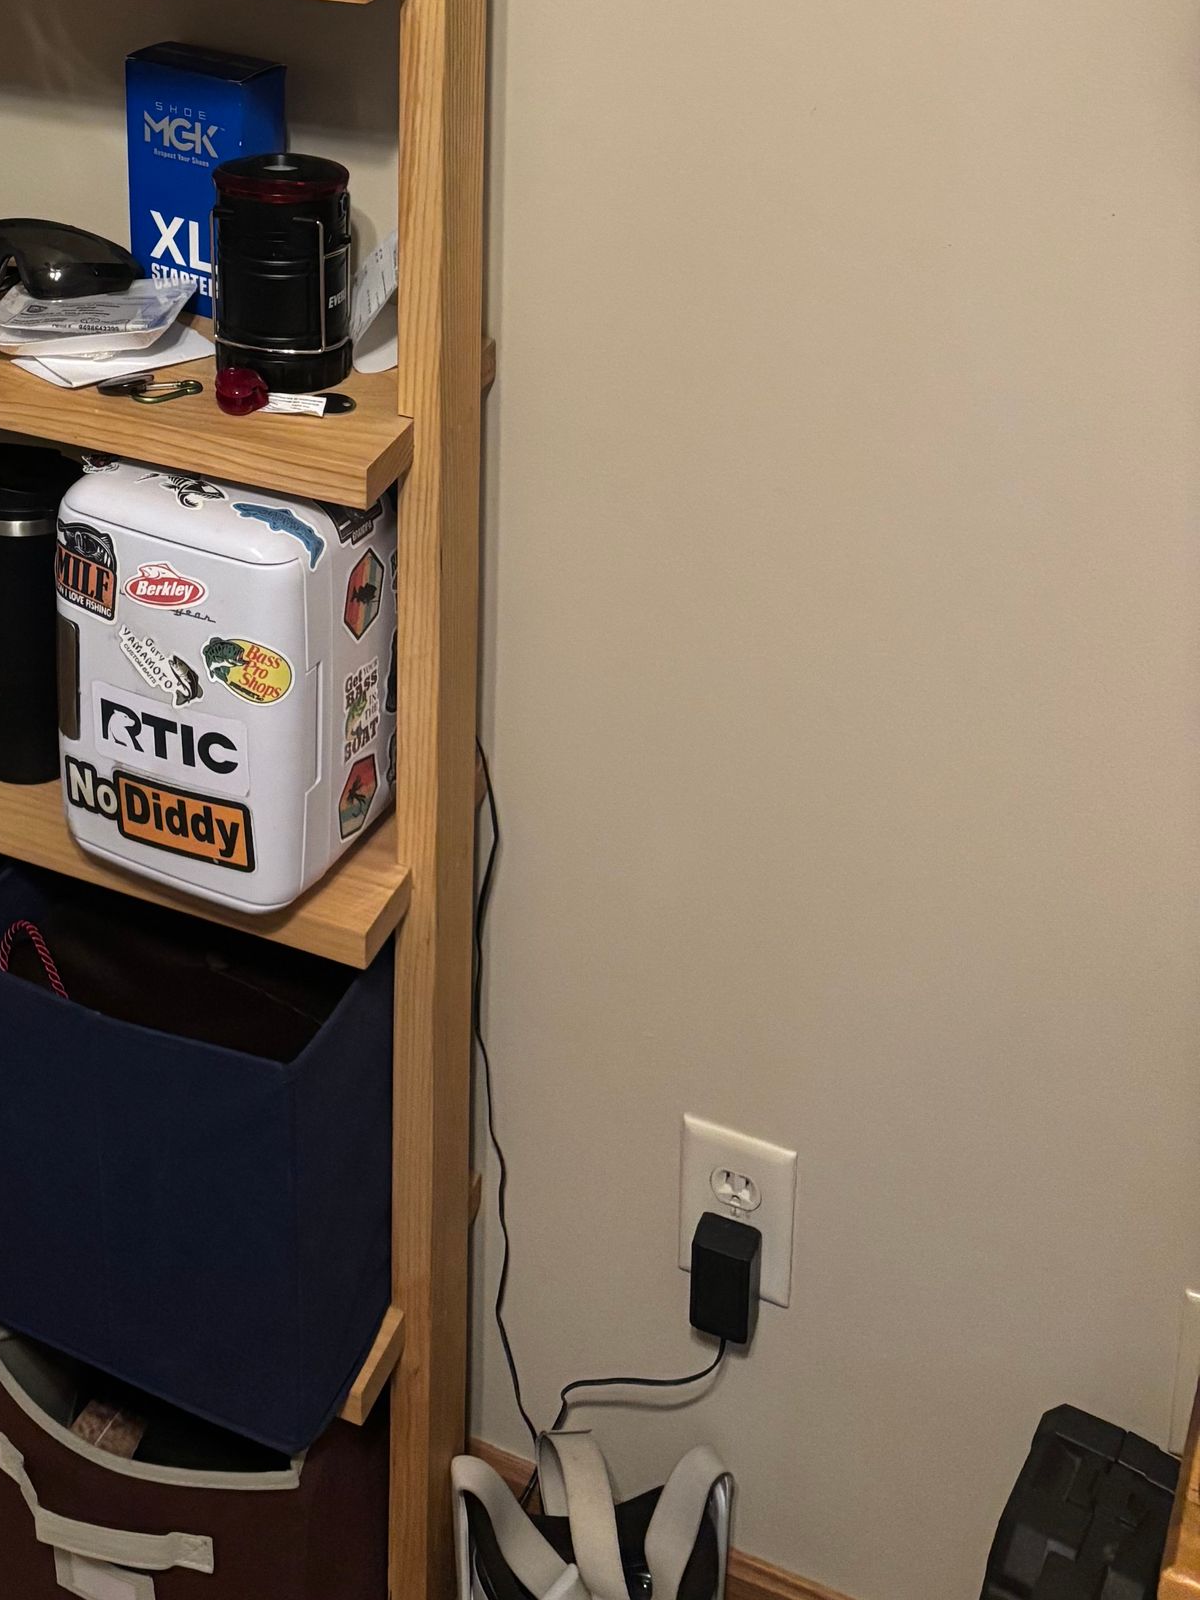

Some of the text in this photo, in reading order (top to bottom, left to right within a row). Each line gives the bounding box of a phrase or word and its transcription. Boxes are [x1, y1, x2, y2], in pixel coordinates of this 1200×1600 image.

[155, 101, 206, 121] SHOE
[143, 110, 219, 159] MGK
[153, 148, 209, 168] Respect Your Shoes
[150, 210, 218, 273] XL
[56, 545, 111, 606] MILF
[68, 591, 85, 605] LOVE
[85, 599, 112, 618] FISHING
[135, 580, 194, 604] Berkley
[122, 627, 173, 689] YAMAMOTO
[145, 638, 166, 662] Gary
[245, 644, 283, 670] Bass
[123, 644, 157, 685] CUSTOM BAITS
[244, 661, 269, 680] Pro
[239, 672, 282, 699] Shops
[345, 669, 363, 694] Get
[101, 697, 239, 775] RTIC
[69, 761, 240, 858] No Diddy
